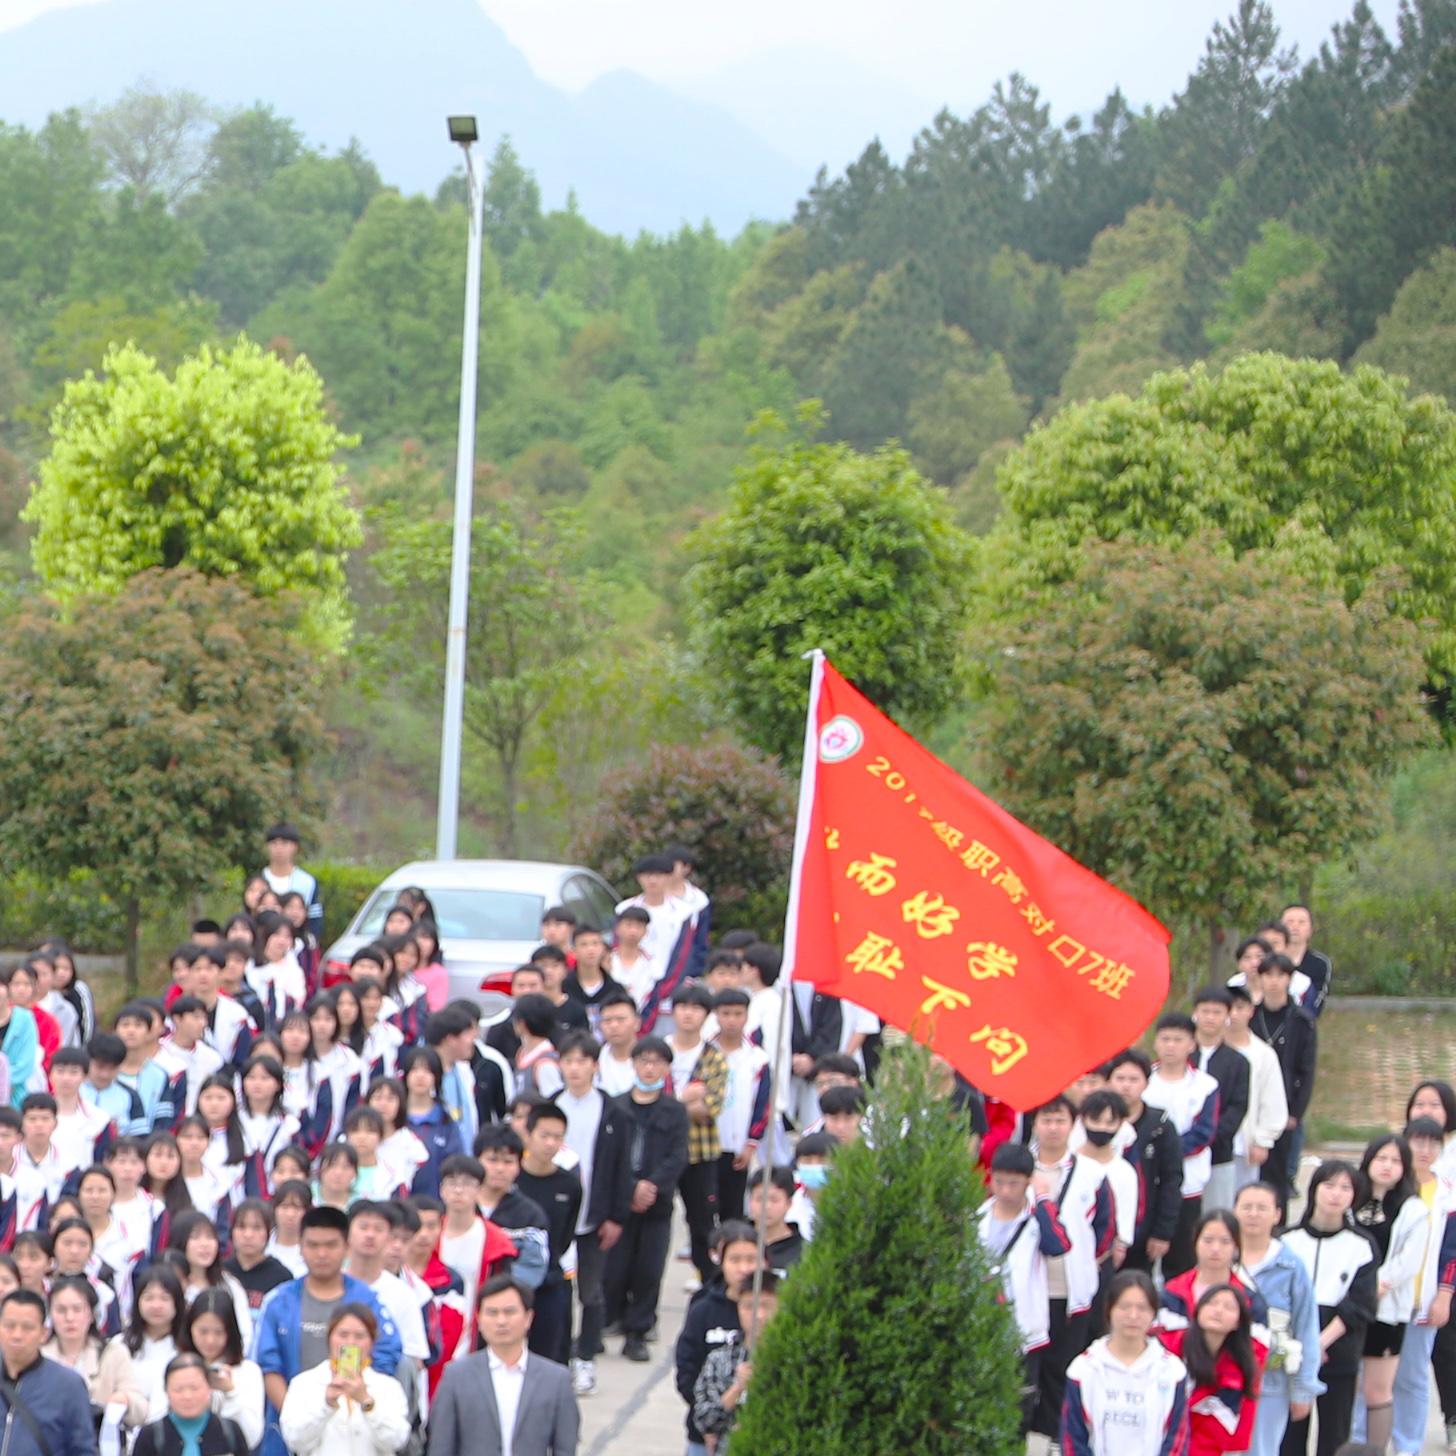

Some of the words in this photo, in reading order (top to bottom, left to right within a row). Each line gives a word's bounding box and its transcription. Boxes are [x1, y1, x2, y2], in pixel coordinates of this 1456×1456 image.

[824, 825, 1019, 980] 而好学
[832, 910, 1029, 1076] 耻下问
